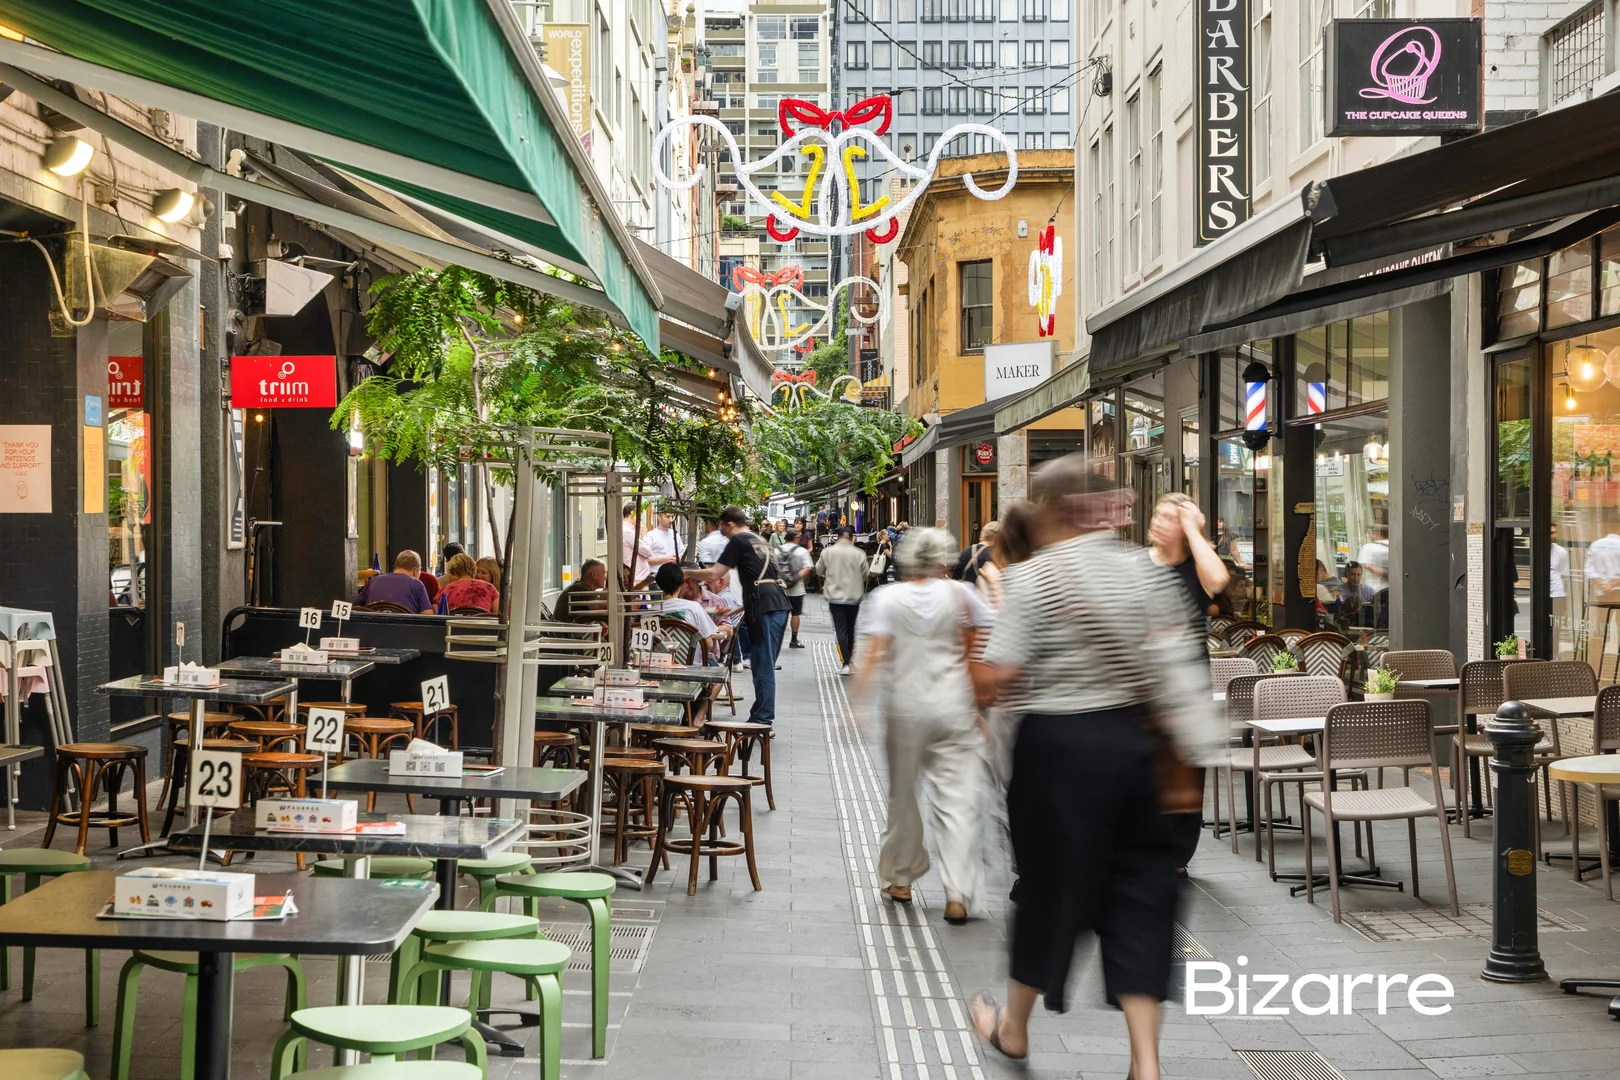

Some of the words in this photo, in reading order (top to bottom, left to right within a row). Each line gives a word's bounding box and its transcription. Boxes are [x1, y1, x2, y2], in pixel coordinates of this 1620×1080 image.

[548, 30, 582, 38] WORLD
[568, 38, 586, 132] expeditions
[1345, 111, 1367, 119] THE
[1369, 111, 1420, 119] CUPCAKE
[1423, 110, 1467, 119] QUEENS
[996, 364, 1040, 379] MAKER
[335, 603, 348, 617] 15
[304, 611, 318, 626] 16
[644, 620, 657, 632] 18
[1548, 614, 1566, 629] THE
[635, 632, 649, 646] 19
[600, 646, 611, 661] 20
[427, 682, 445, 708] 21
[312, 715, 338, 744] 22
[198, 760, 232, 797] 23
